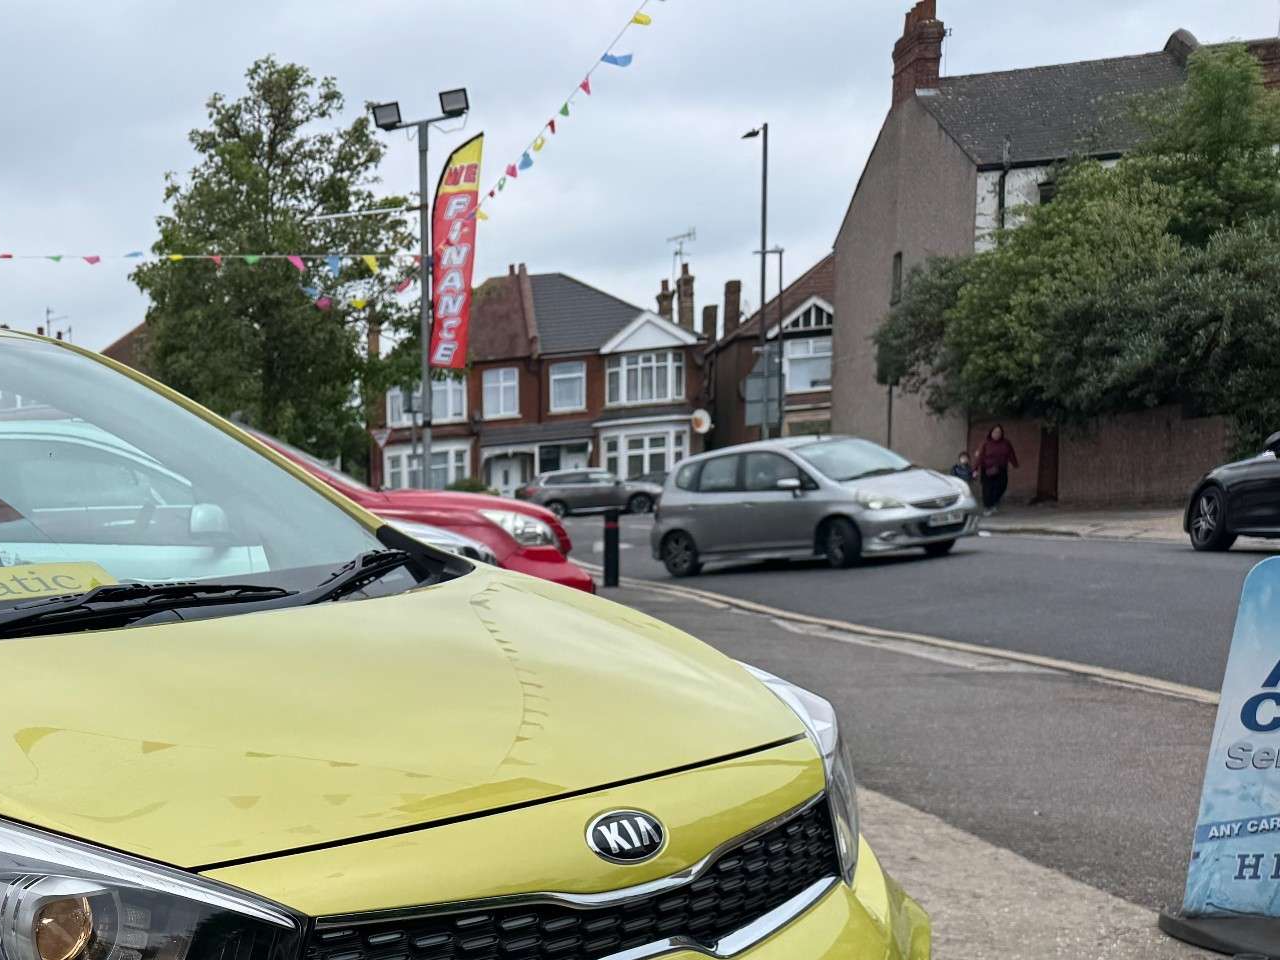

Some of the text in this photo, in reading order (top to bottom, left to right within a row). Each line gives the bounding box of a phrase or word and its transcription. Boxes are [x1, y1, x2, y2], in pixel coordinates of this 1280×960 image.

[444, 163, 479, 186] WE
[432, 194, 470, 365] FINANCE
[597, 816, 660, 854] KIA
[1208, 822, 1242, 840] ANY
